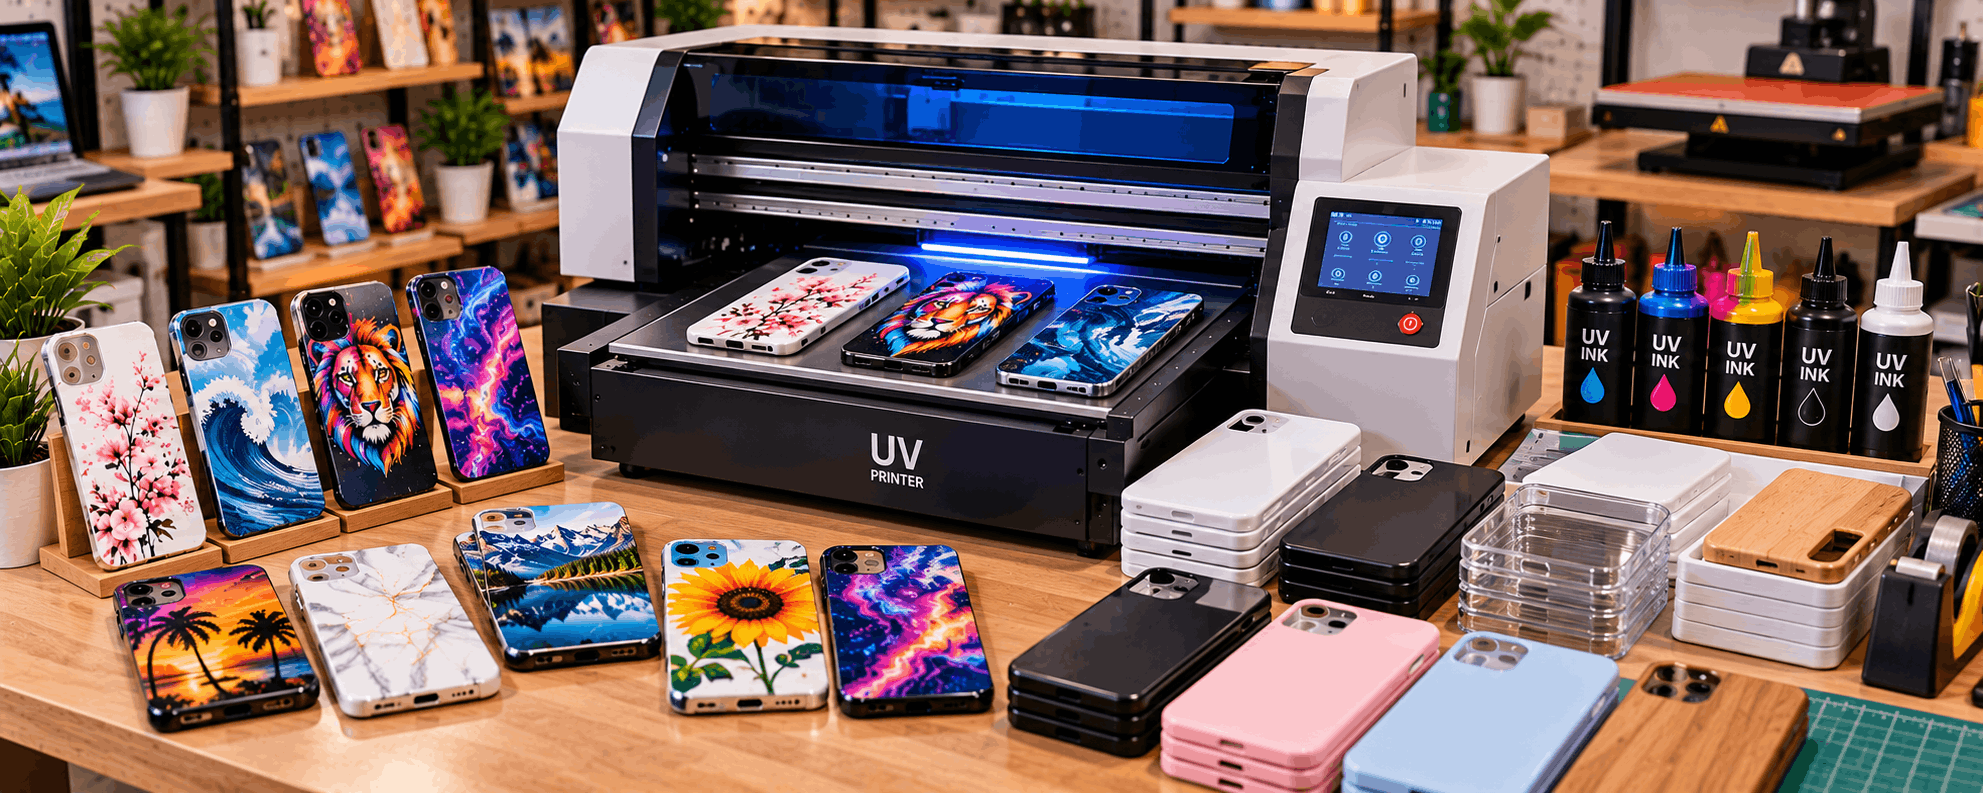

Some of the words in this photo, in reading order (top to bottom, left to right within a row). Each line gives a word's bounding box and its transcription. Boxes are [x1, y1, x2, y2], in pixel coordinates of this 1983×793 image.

[1582, 327, 1611, 346] UV
[1652, 333, 1683, 353] UV
[1581, 346, 1609, 363] INK
[1726, 340, 1757, 360] UV
[1801, 346, 1833, 366] UV
[1651, 352, 1680, 370] INK
[1725, 359, 1756, 377] INK
[1875, 351, 1908, 371] UV
[1799, 365, 1832, 383] INK
[1874, 371, 1906, 388] INK
[870, 432, 924, 471] UV
[870, 468, 924, 489] PRINTER
